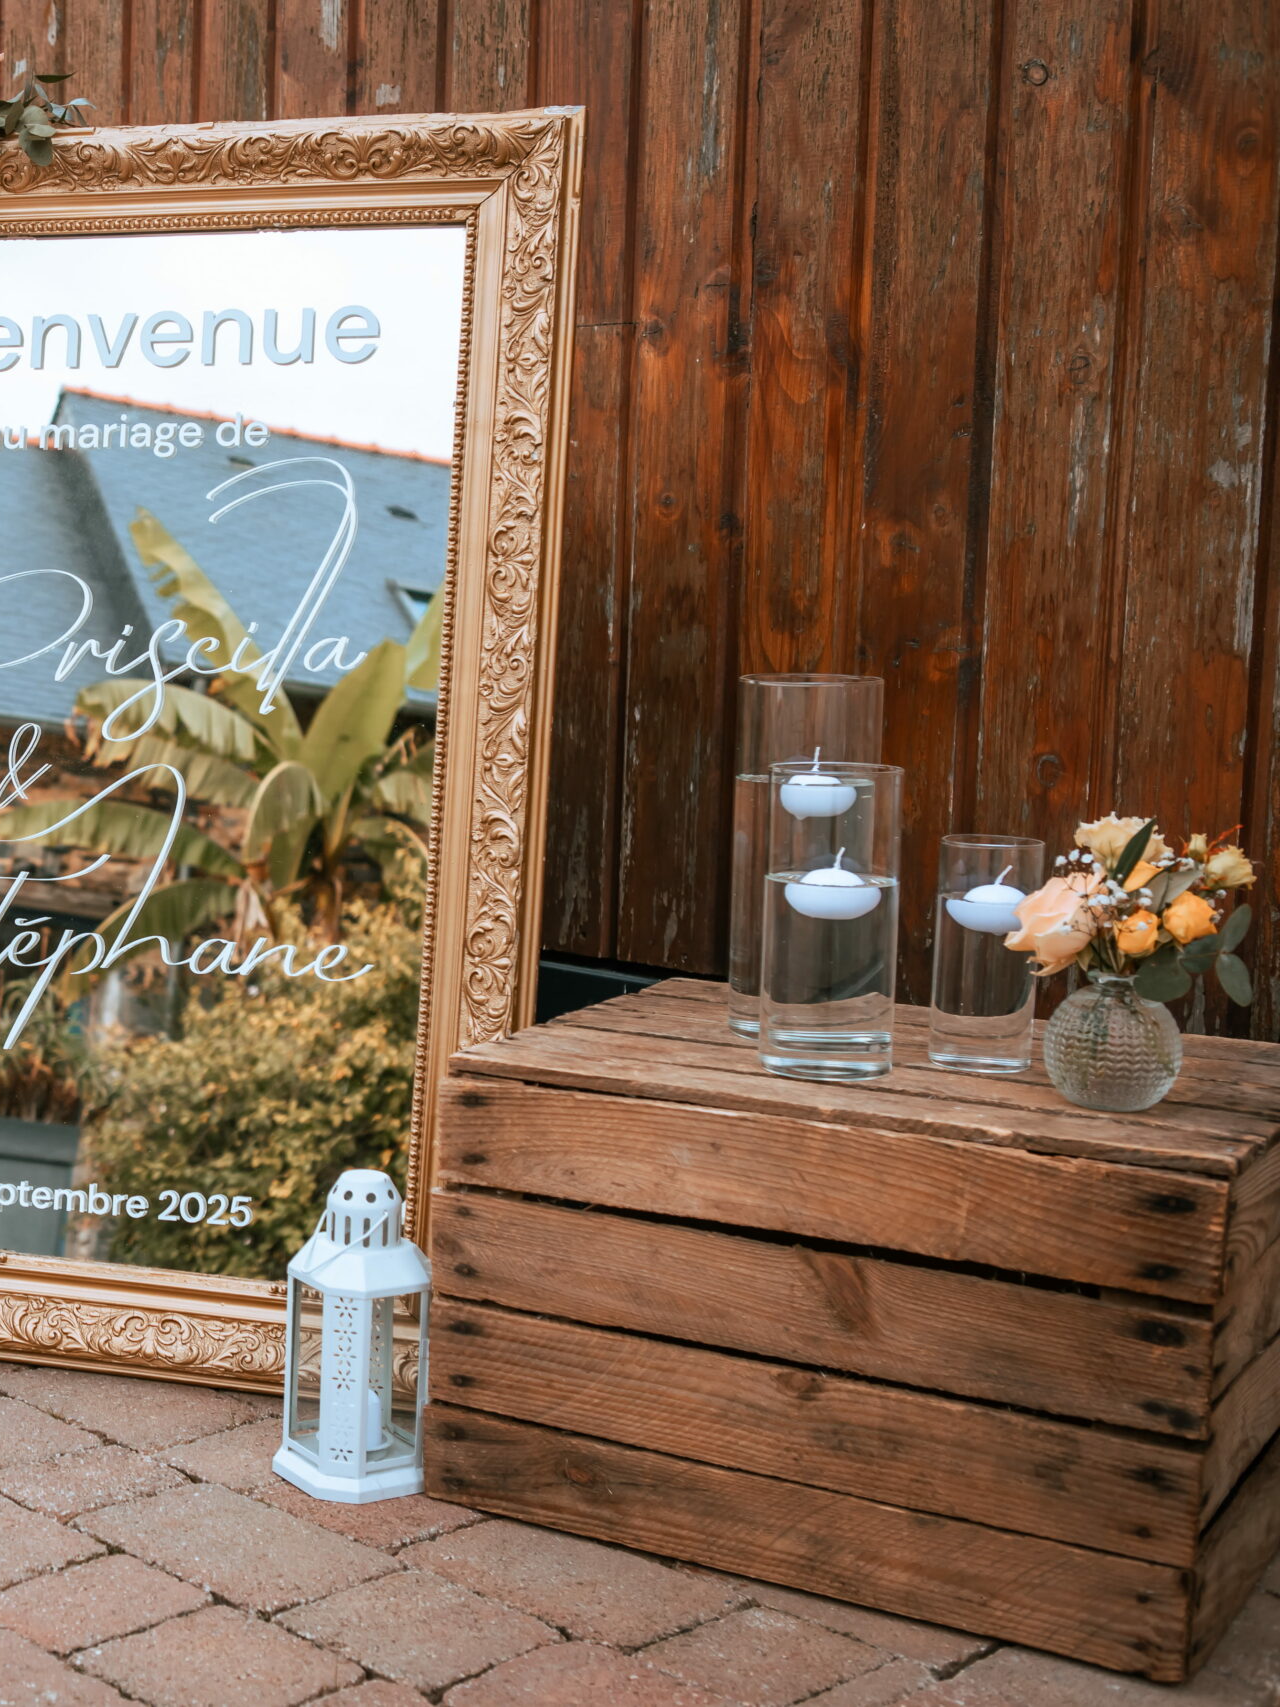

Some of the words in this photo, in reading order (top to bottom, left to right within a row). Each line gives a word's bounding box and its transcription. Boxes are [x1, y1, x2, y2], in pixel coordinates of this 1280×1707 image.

[38, 414, 206, 457] mariage
[215, 413, 269, 447] de
[157, 1189, 254, 1227] 2025
